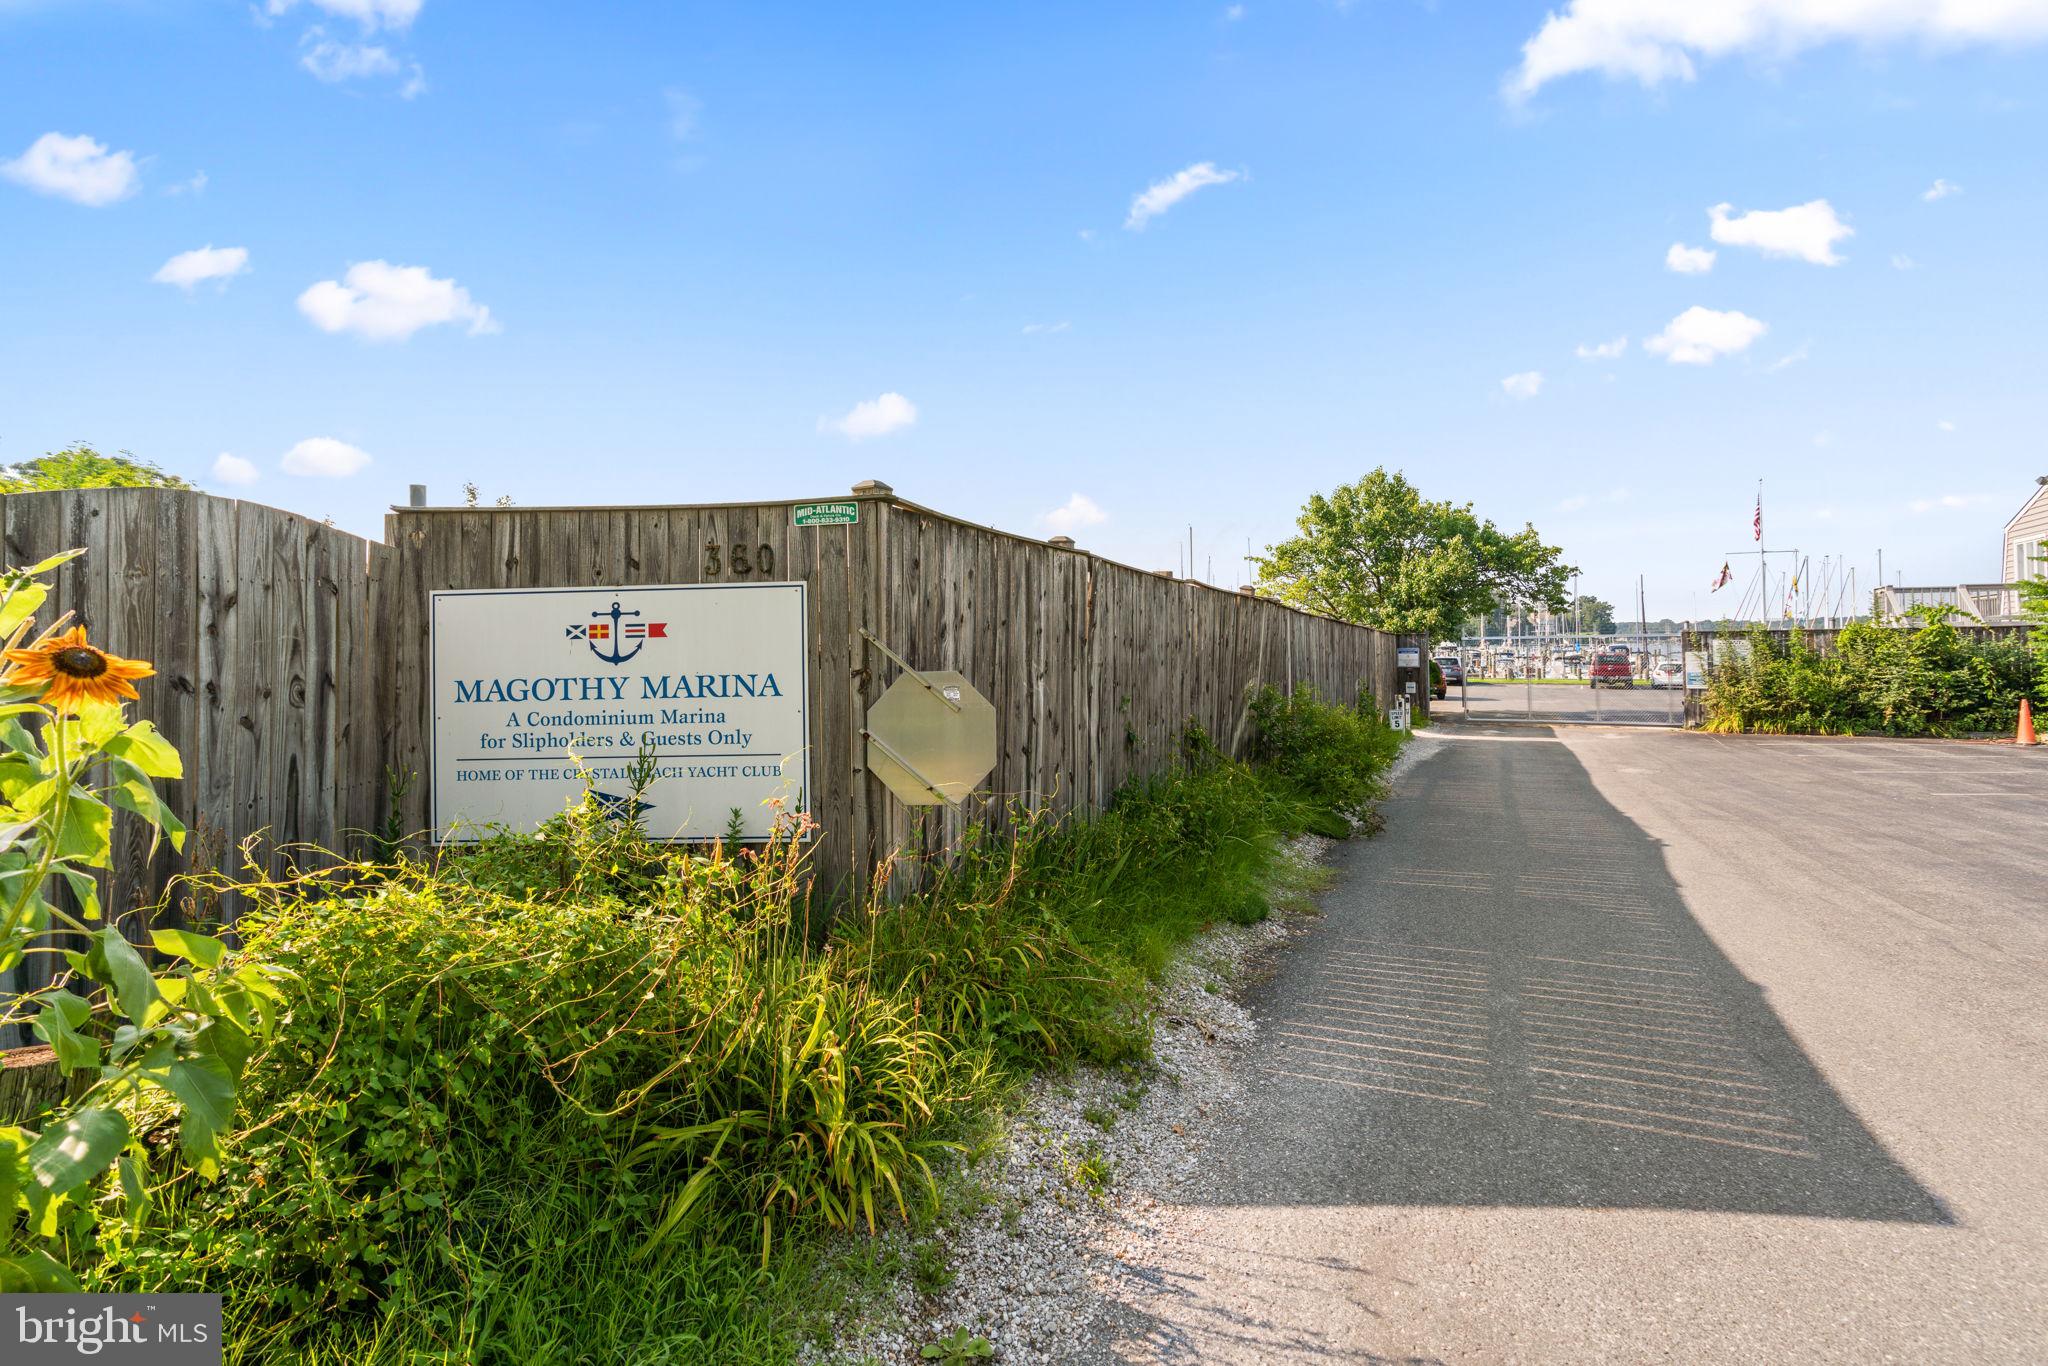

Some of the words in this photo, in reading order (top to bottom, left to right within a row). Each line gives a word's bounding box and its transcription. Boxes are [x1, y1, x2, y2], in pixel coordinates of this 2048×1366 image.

[796, 505, 855, 518] MID-ATLANTIC
[704, 543, 775, 576] 360
[454, 676, 630, 703] MAGOTHY
[640, 672, 783, 699] MARINA
[506, 712, 520, 727] A
[527, 709, 654, 727] Condominium
[660, 707, 726, 724] Marina
[1394, 720, 1400, 728] 5
[480, 733, 506, 749] for
[512, 731, 614, 752] Slipholders
[620, 731, 635, 747] &
[641, 730, 702, 747] Guests
[708, 729, 752, 748] Only
[456, 769, 501, 781] HOME
[505, 769, 525, 780] OF
[528, 768, 560, 780] THE
[688, 766, 738, 778] YACHT
[742, 765, 782, 777] CLUB
